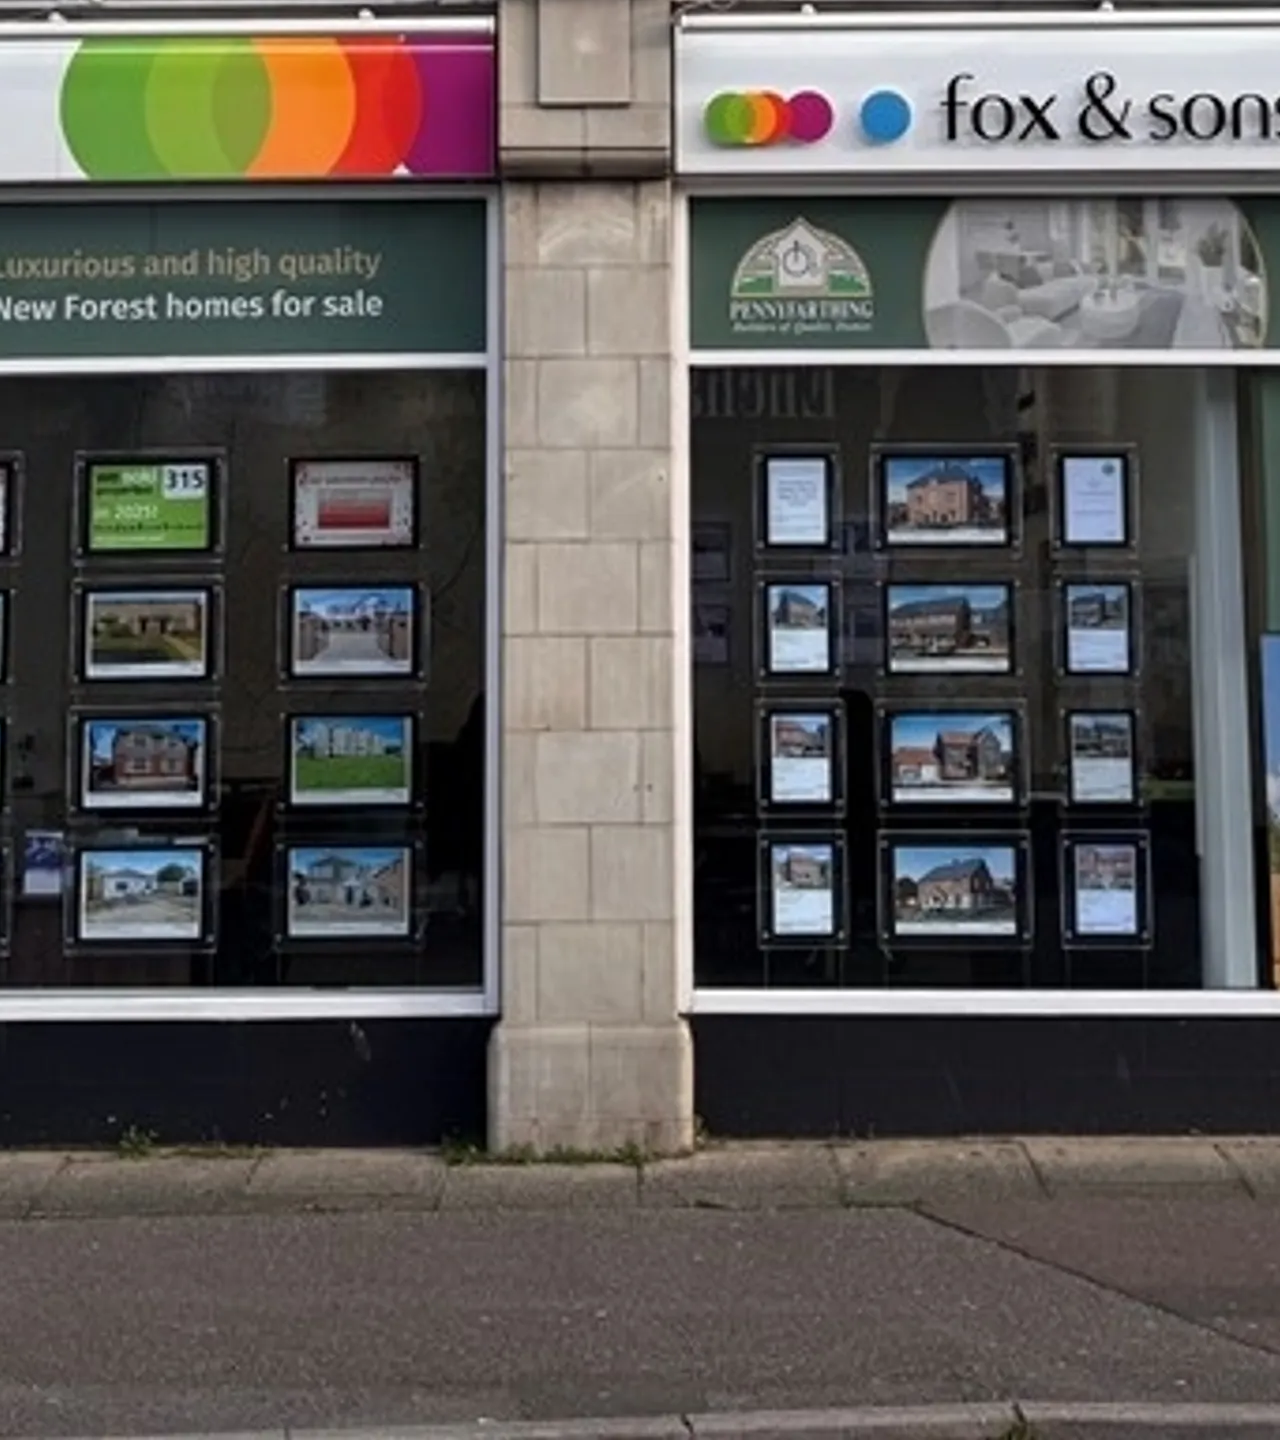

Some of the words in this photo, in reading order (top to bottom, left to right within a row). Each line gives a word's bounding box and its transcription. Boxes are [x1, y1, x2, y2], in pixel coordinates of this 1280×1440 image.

[940, 74, 1060, 141] fox
[1077, 72, 1132, 141] &
[144, 248, 198, 278] and
[208, 247, 270, 284] high
[279, 246, 382, 282] quality
[65, 292, 158, 321] Forest
[166, 291, 265, 320] homes
[271, 290, 314, 319] for
[322, 289, 383, 318] sale
[167, 469, 205, 489] 315
